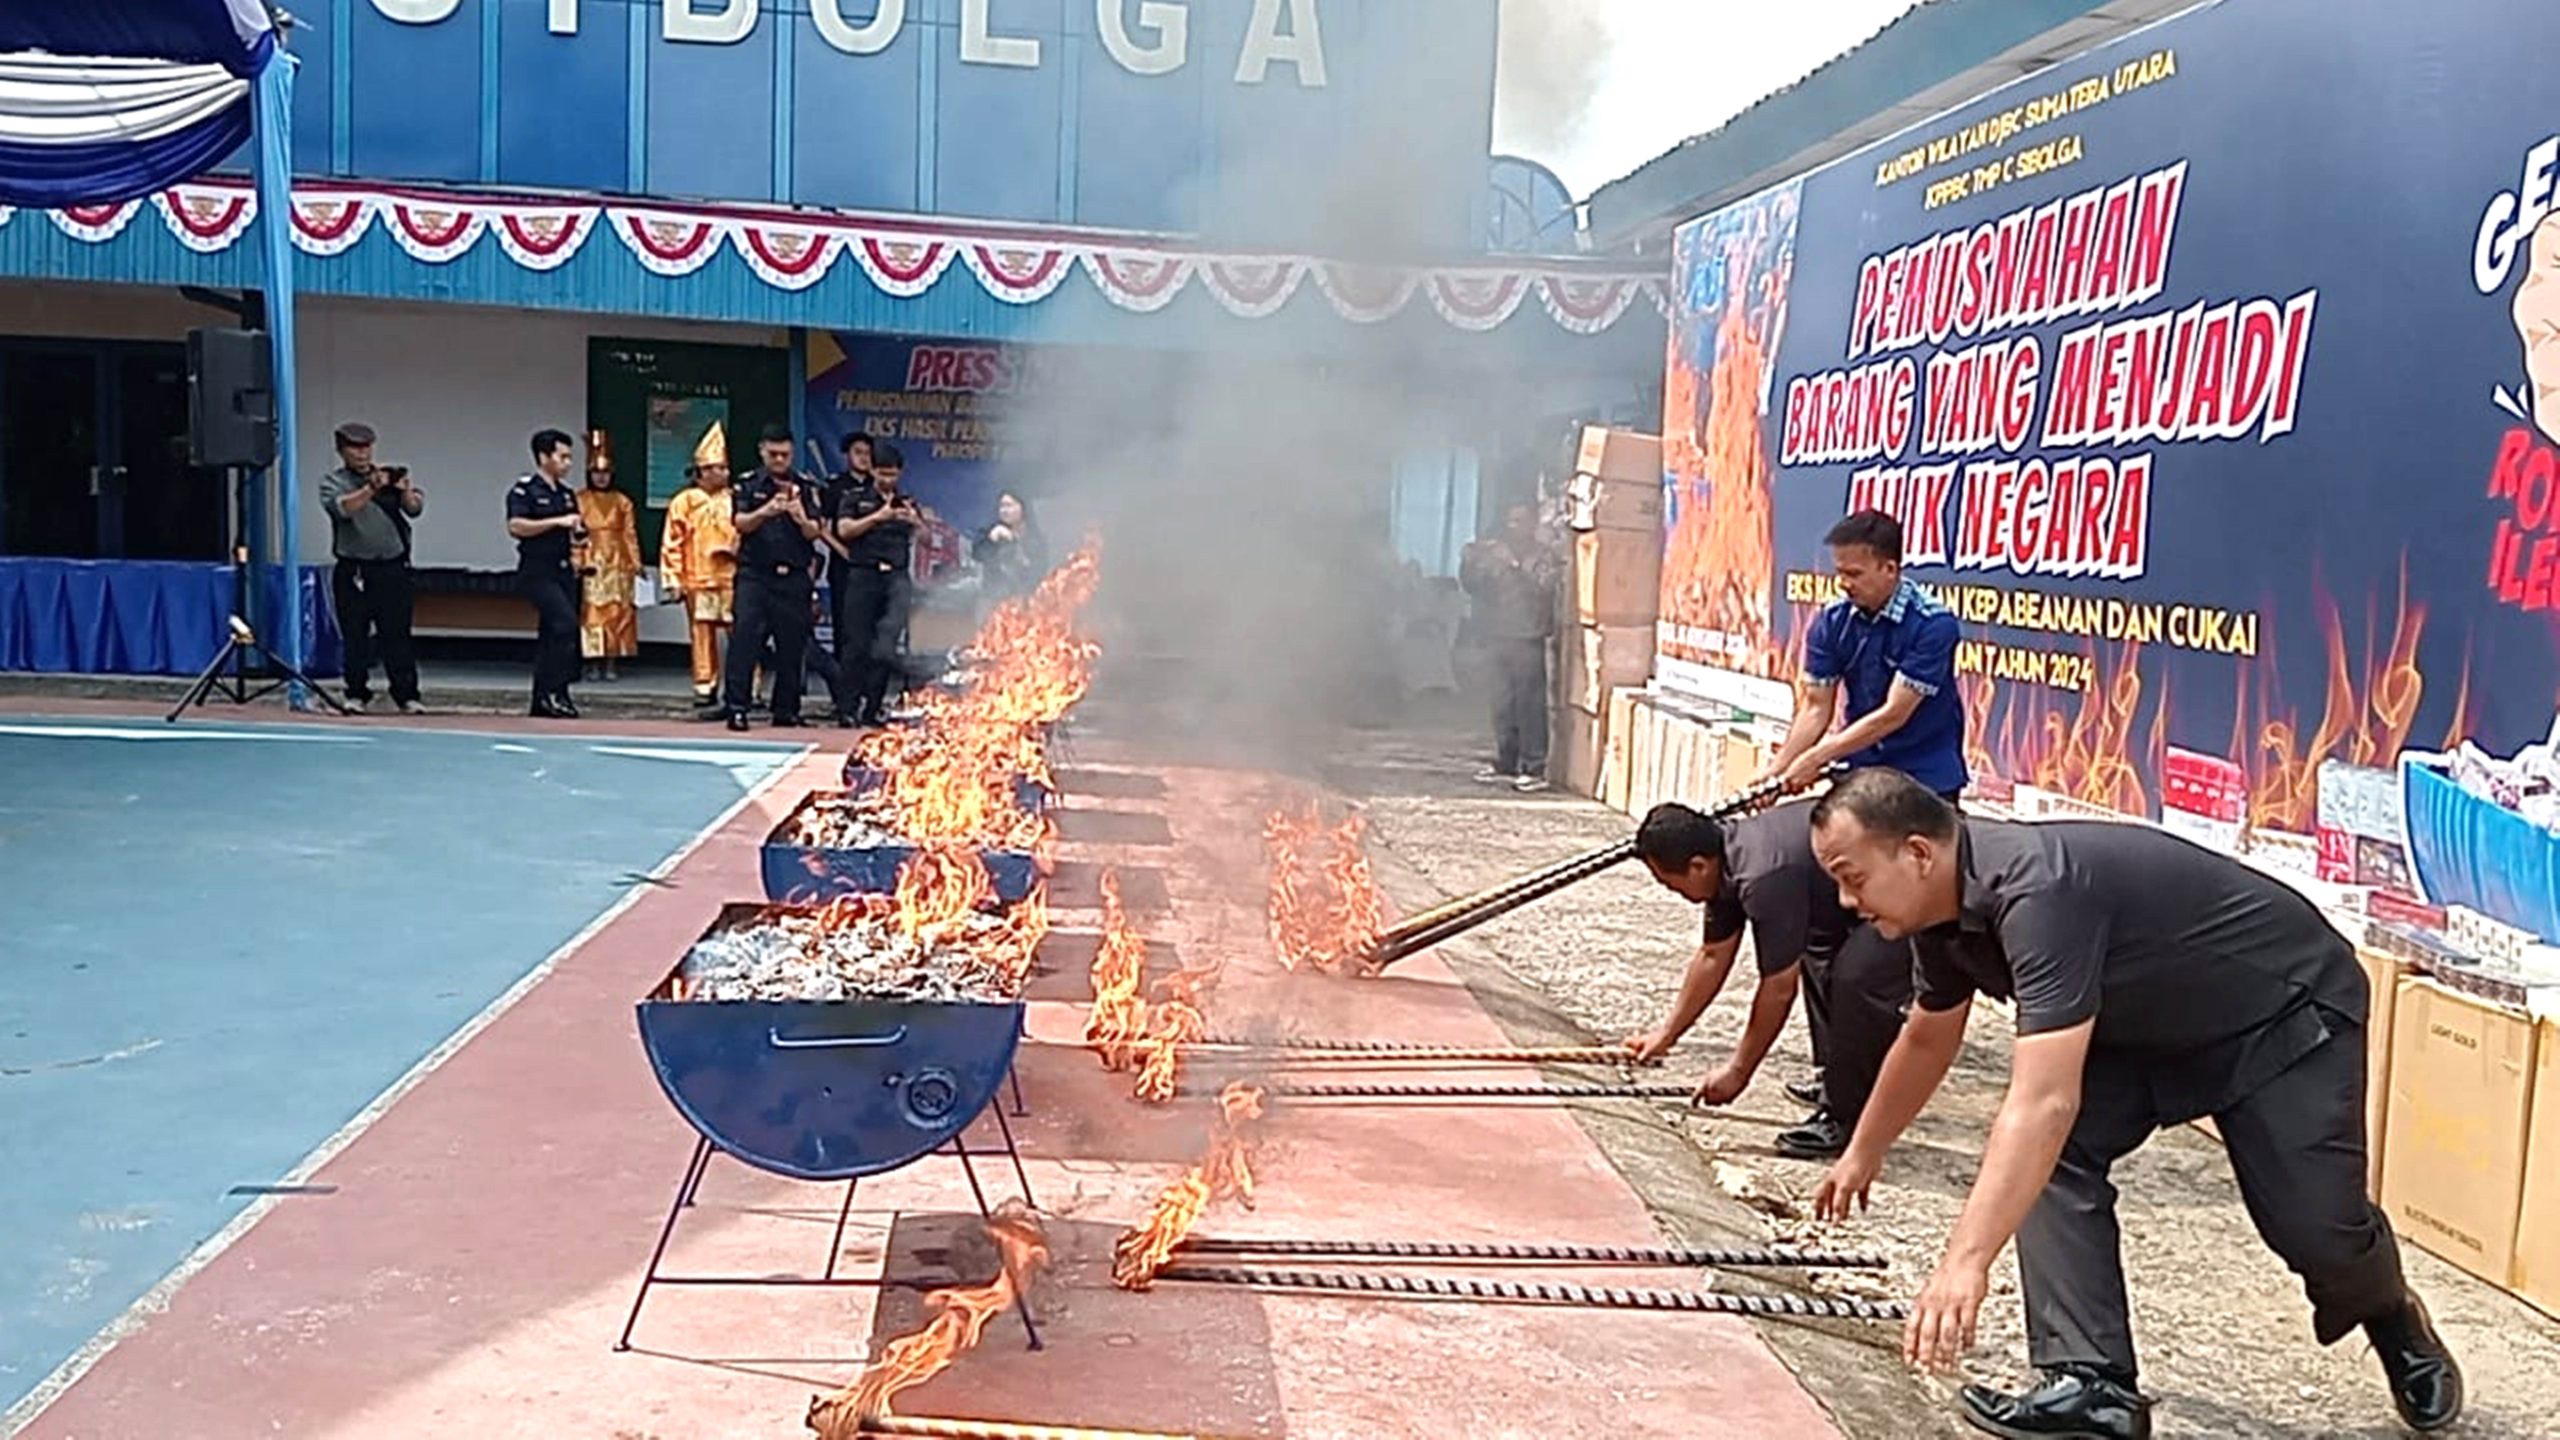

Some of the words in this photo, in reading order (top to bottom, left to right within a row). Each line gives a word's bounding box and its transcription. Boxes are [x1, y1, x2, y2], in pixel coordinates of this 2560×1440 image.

[1876, 147, 1926, 187] KANTOR
[2023, 75, 2111, 129] SUMATERA
[2112, 49, 2176, 95] UTARA
[1924, 171, 1971, 211] KPPBC
[1972, 162, 2002, 195] TMP
[2002, 155, 2015, 183] C
[2015, 134, 2083, 179] SIBOLGA
[1849, 160, 2188, 359] PEMUSNAHAN
[2472, 133, 2560, 293] GE
[1780, 357, 1916, 466] BARANG
[1920, 336, 2040, 454] YANG
[2040, 290, 2317, 448] MENJADI
[1953, 452, 2152, 580] NEGARA
[2487, 428, 2560, 532] RO
[1785, 573, 1813, 603] EKS
[1961, 585, 2103, 636] KEPABEANAN
[2106, 605, 2165, 645] DAN
[2167, 604, 2259, 657] CUKAI
[1984, 642, 2047, 683] TAHUN
[2049, 654, 2095, 692] 2024
